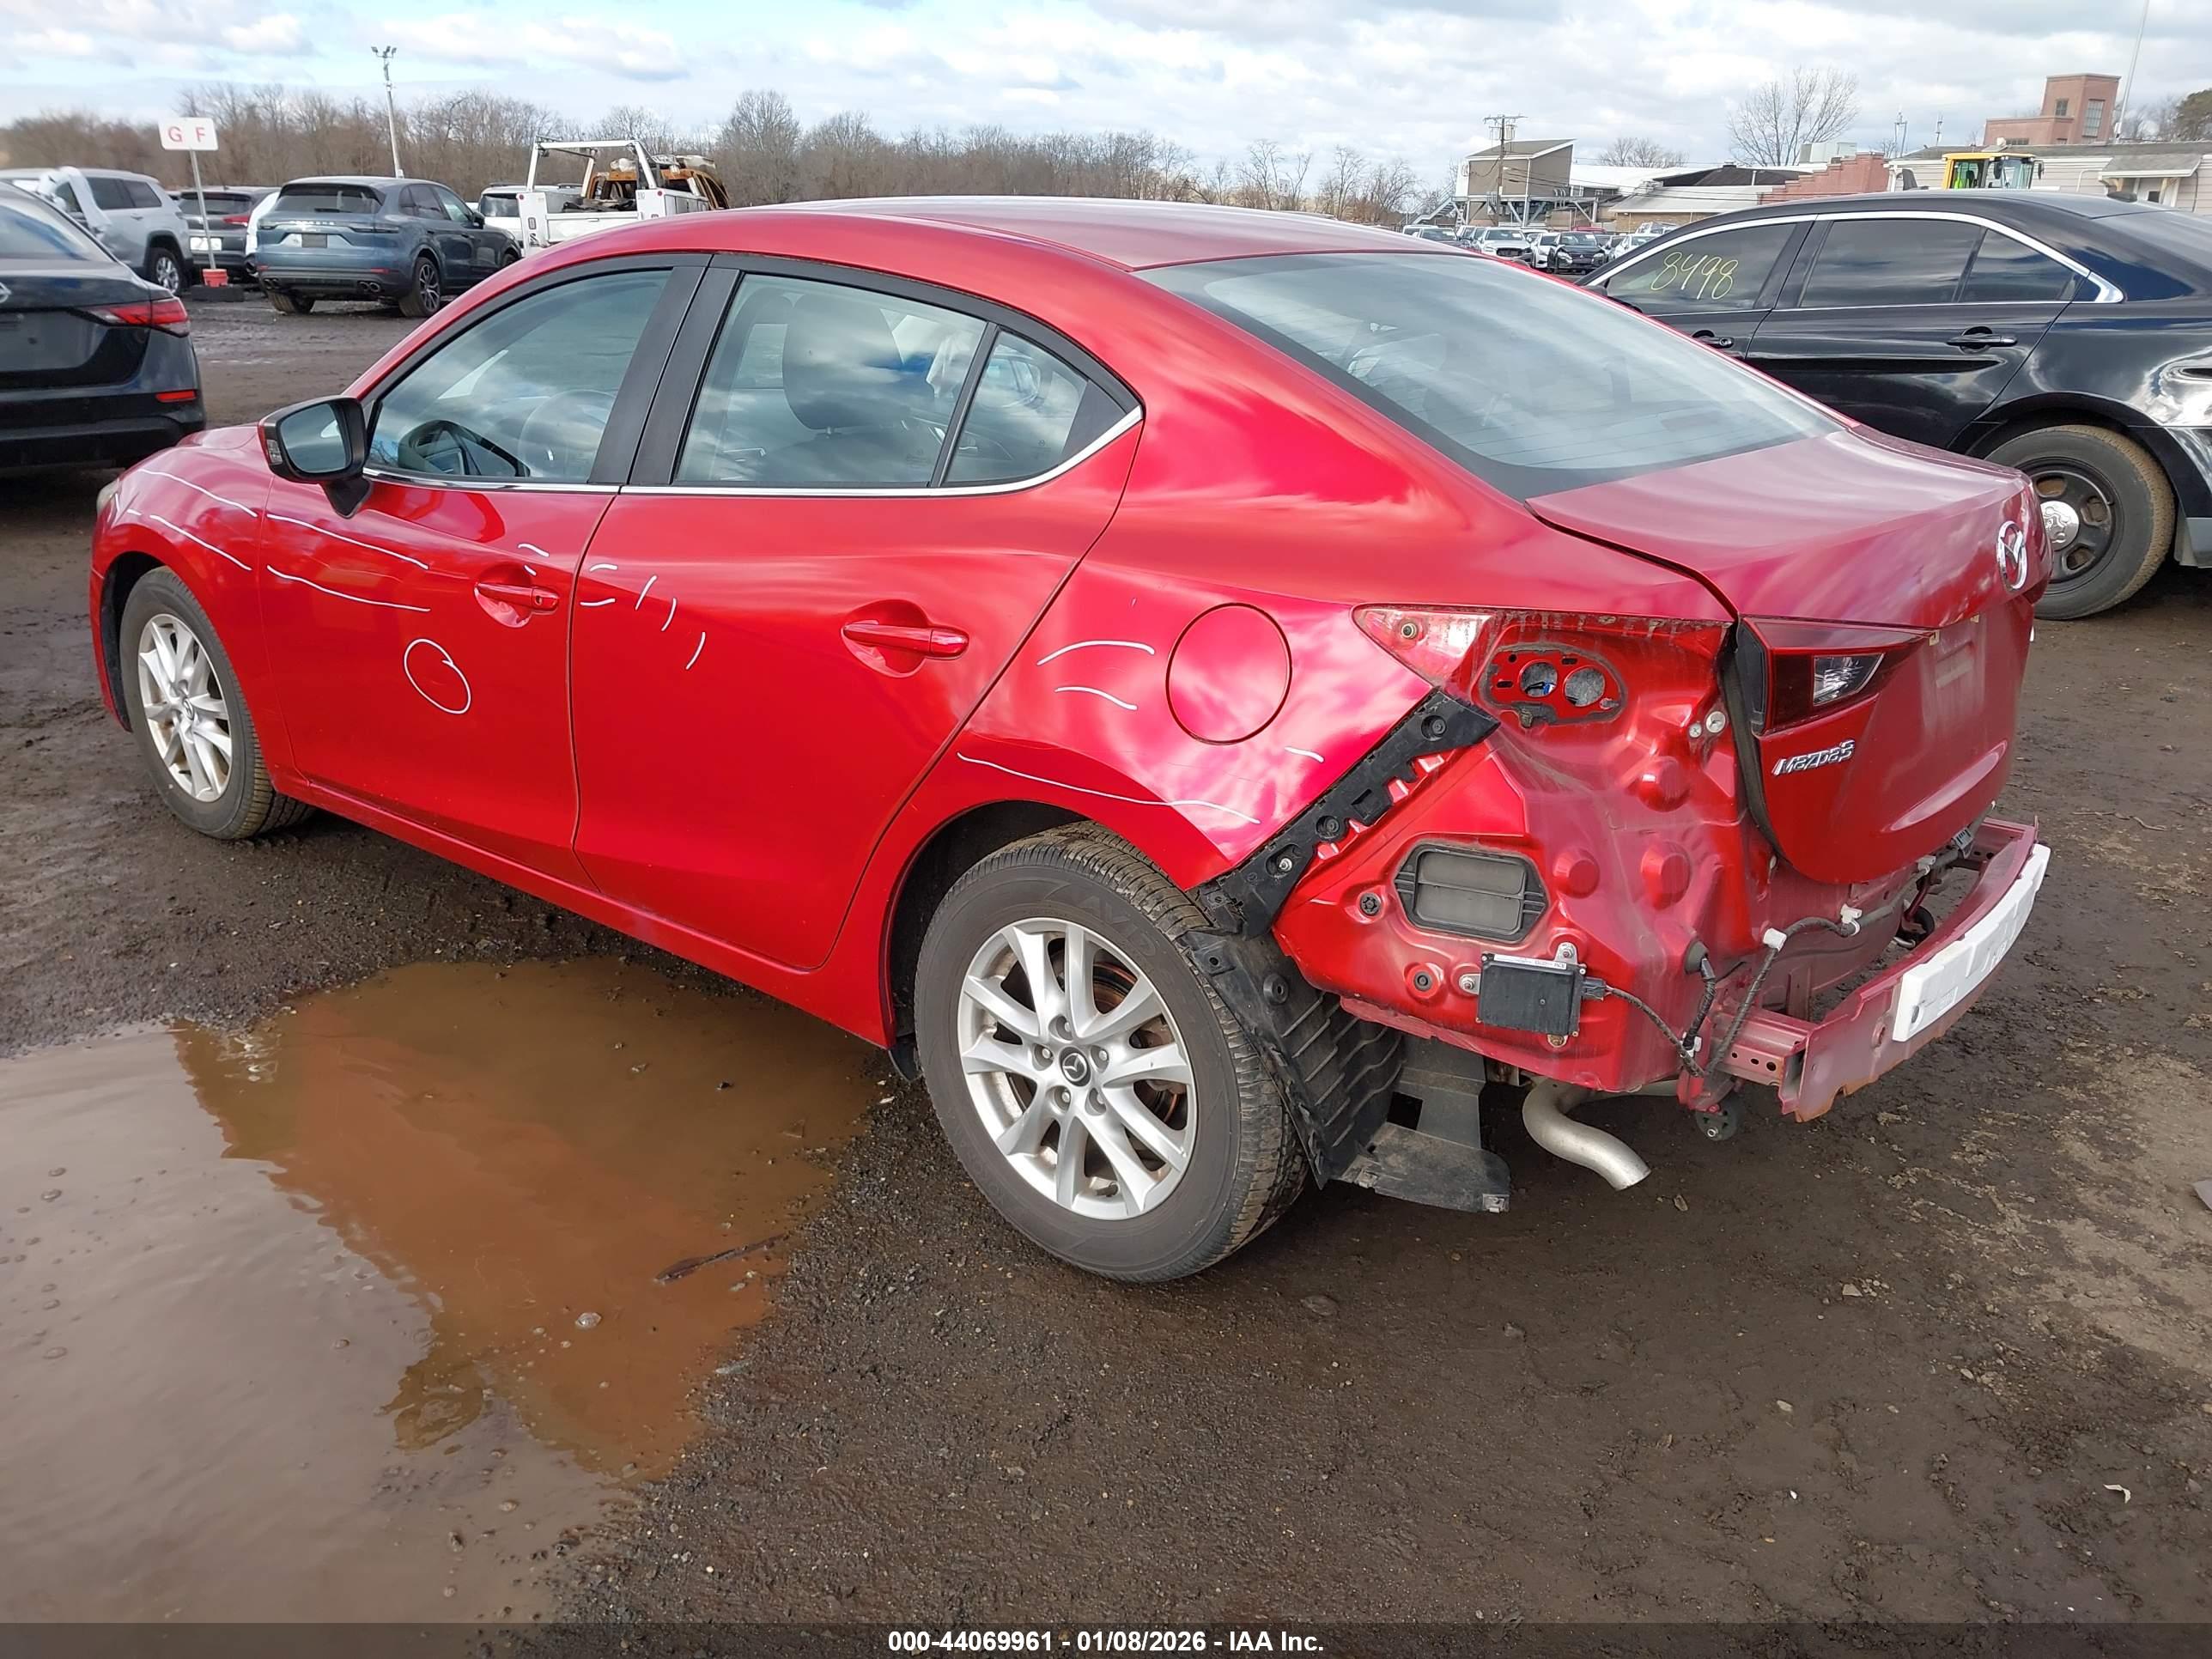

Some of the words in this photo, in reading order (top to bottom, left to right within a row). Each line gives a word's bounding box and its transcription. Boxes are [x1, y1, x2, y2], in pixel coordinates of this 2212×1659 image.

[168, 125, 183, 143] G
[195, 126, 206, 143] F
[1650, 252, 1738, 300] 8498
